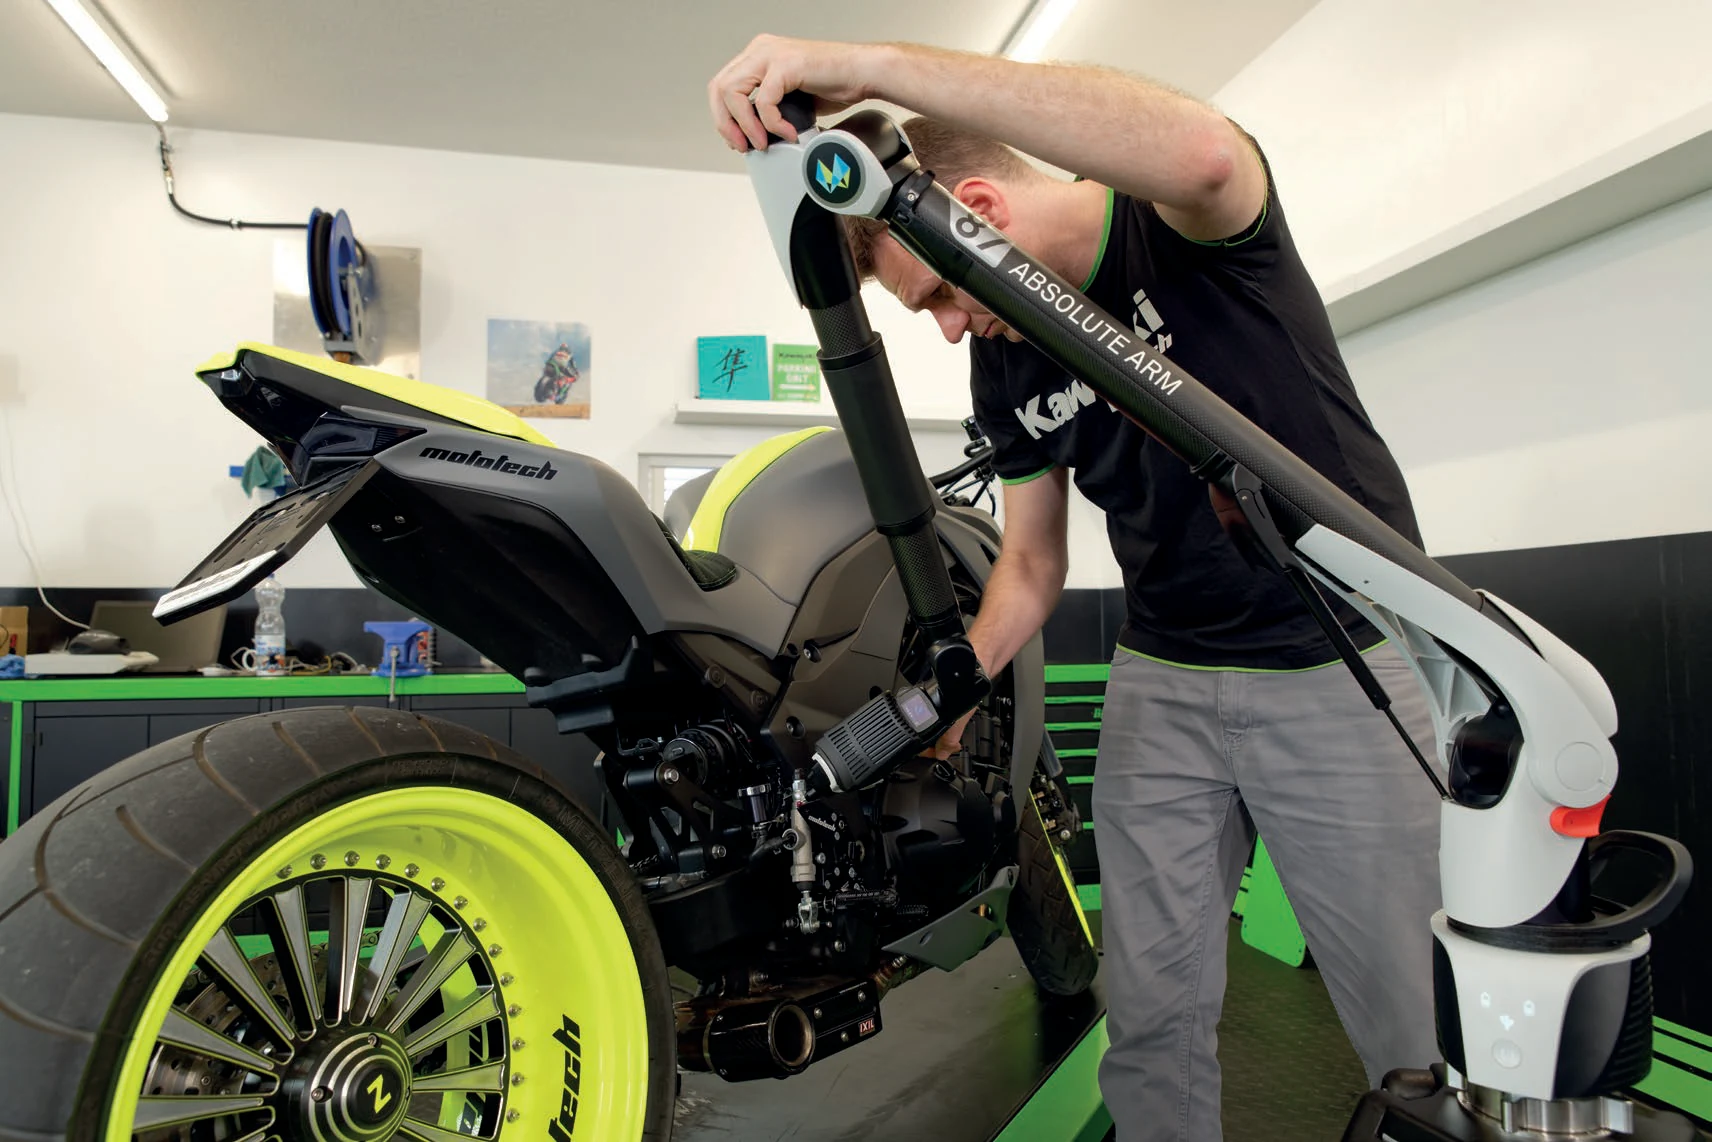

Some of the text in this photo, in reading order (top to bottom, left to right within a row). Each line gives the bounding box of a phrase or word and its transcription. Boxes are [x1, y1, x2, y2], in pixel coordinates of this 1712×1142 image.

[1008, 262, 1184, 396] ABSOLUTE ARM
[419, 447, 558, 480] mototech
